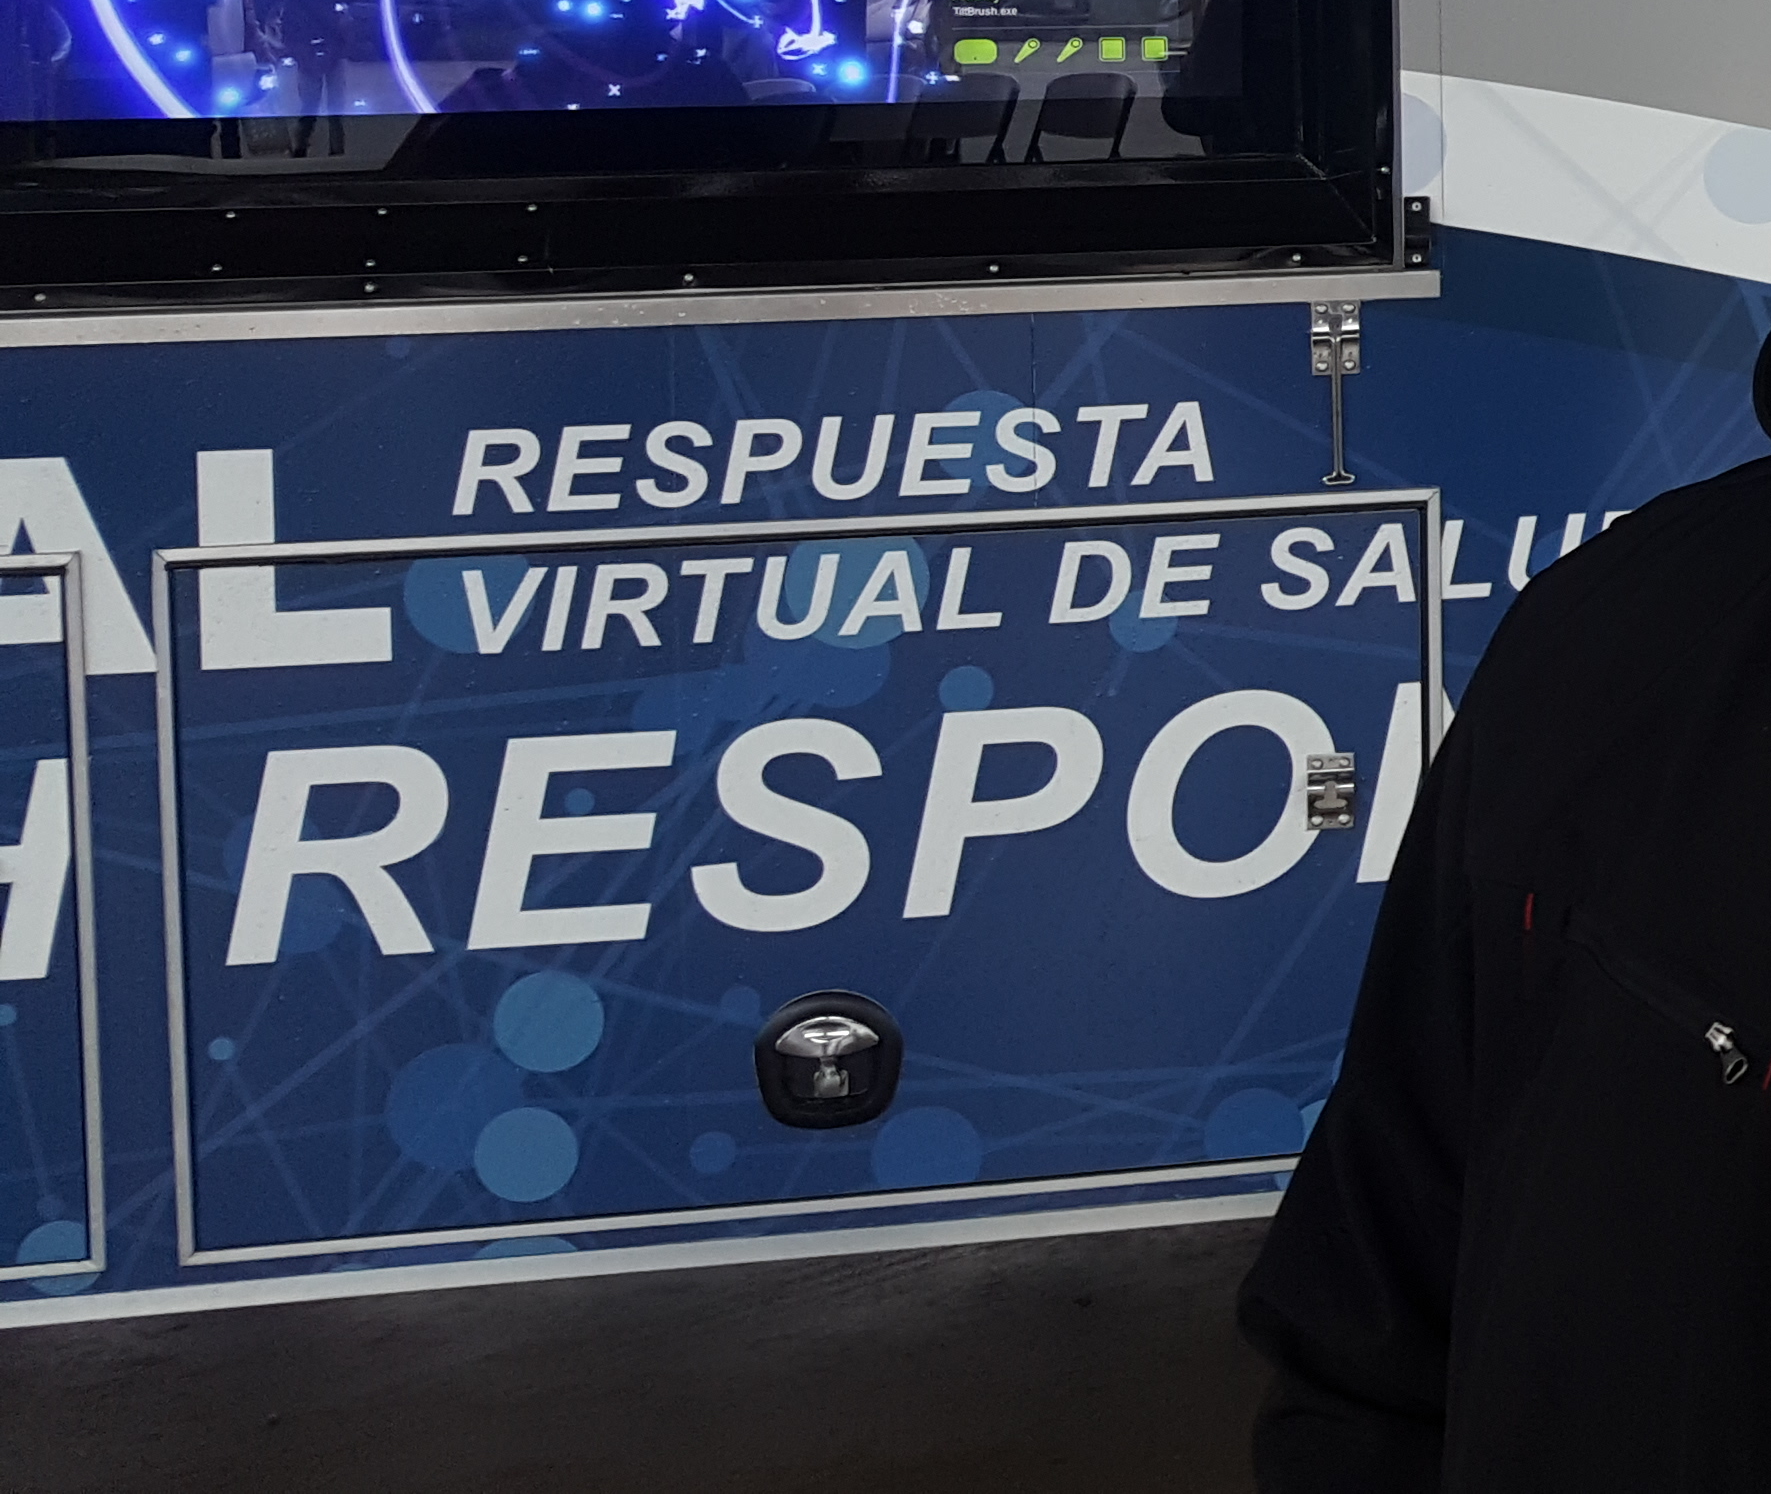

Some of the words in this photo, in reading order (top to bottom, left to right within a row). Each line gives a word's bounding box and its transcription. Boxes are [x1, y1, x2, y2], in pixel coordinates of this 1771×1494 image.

[451, 401, 1215, 515] RESPUESTA
[461, 548, 1003, 655] VIRTUAL
[1049, 533, 1222, 626] DE
[1260, 509, 1638, 611] SALU
